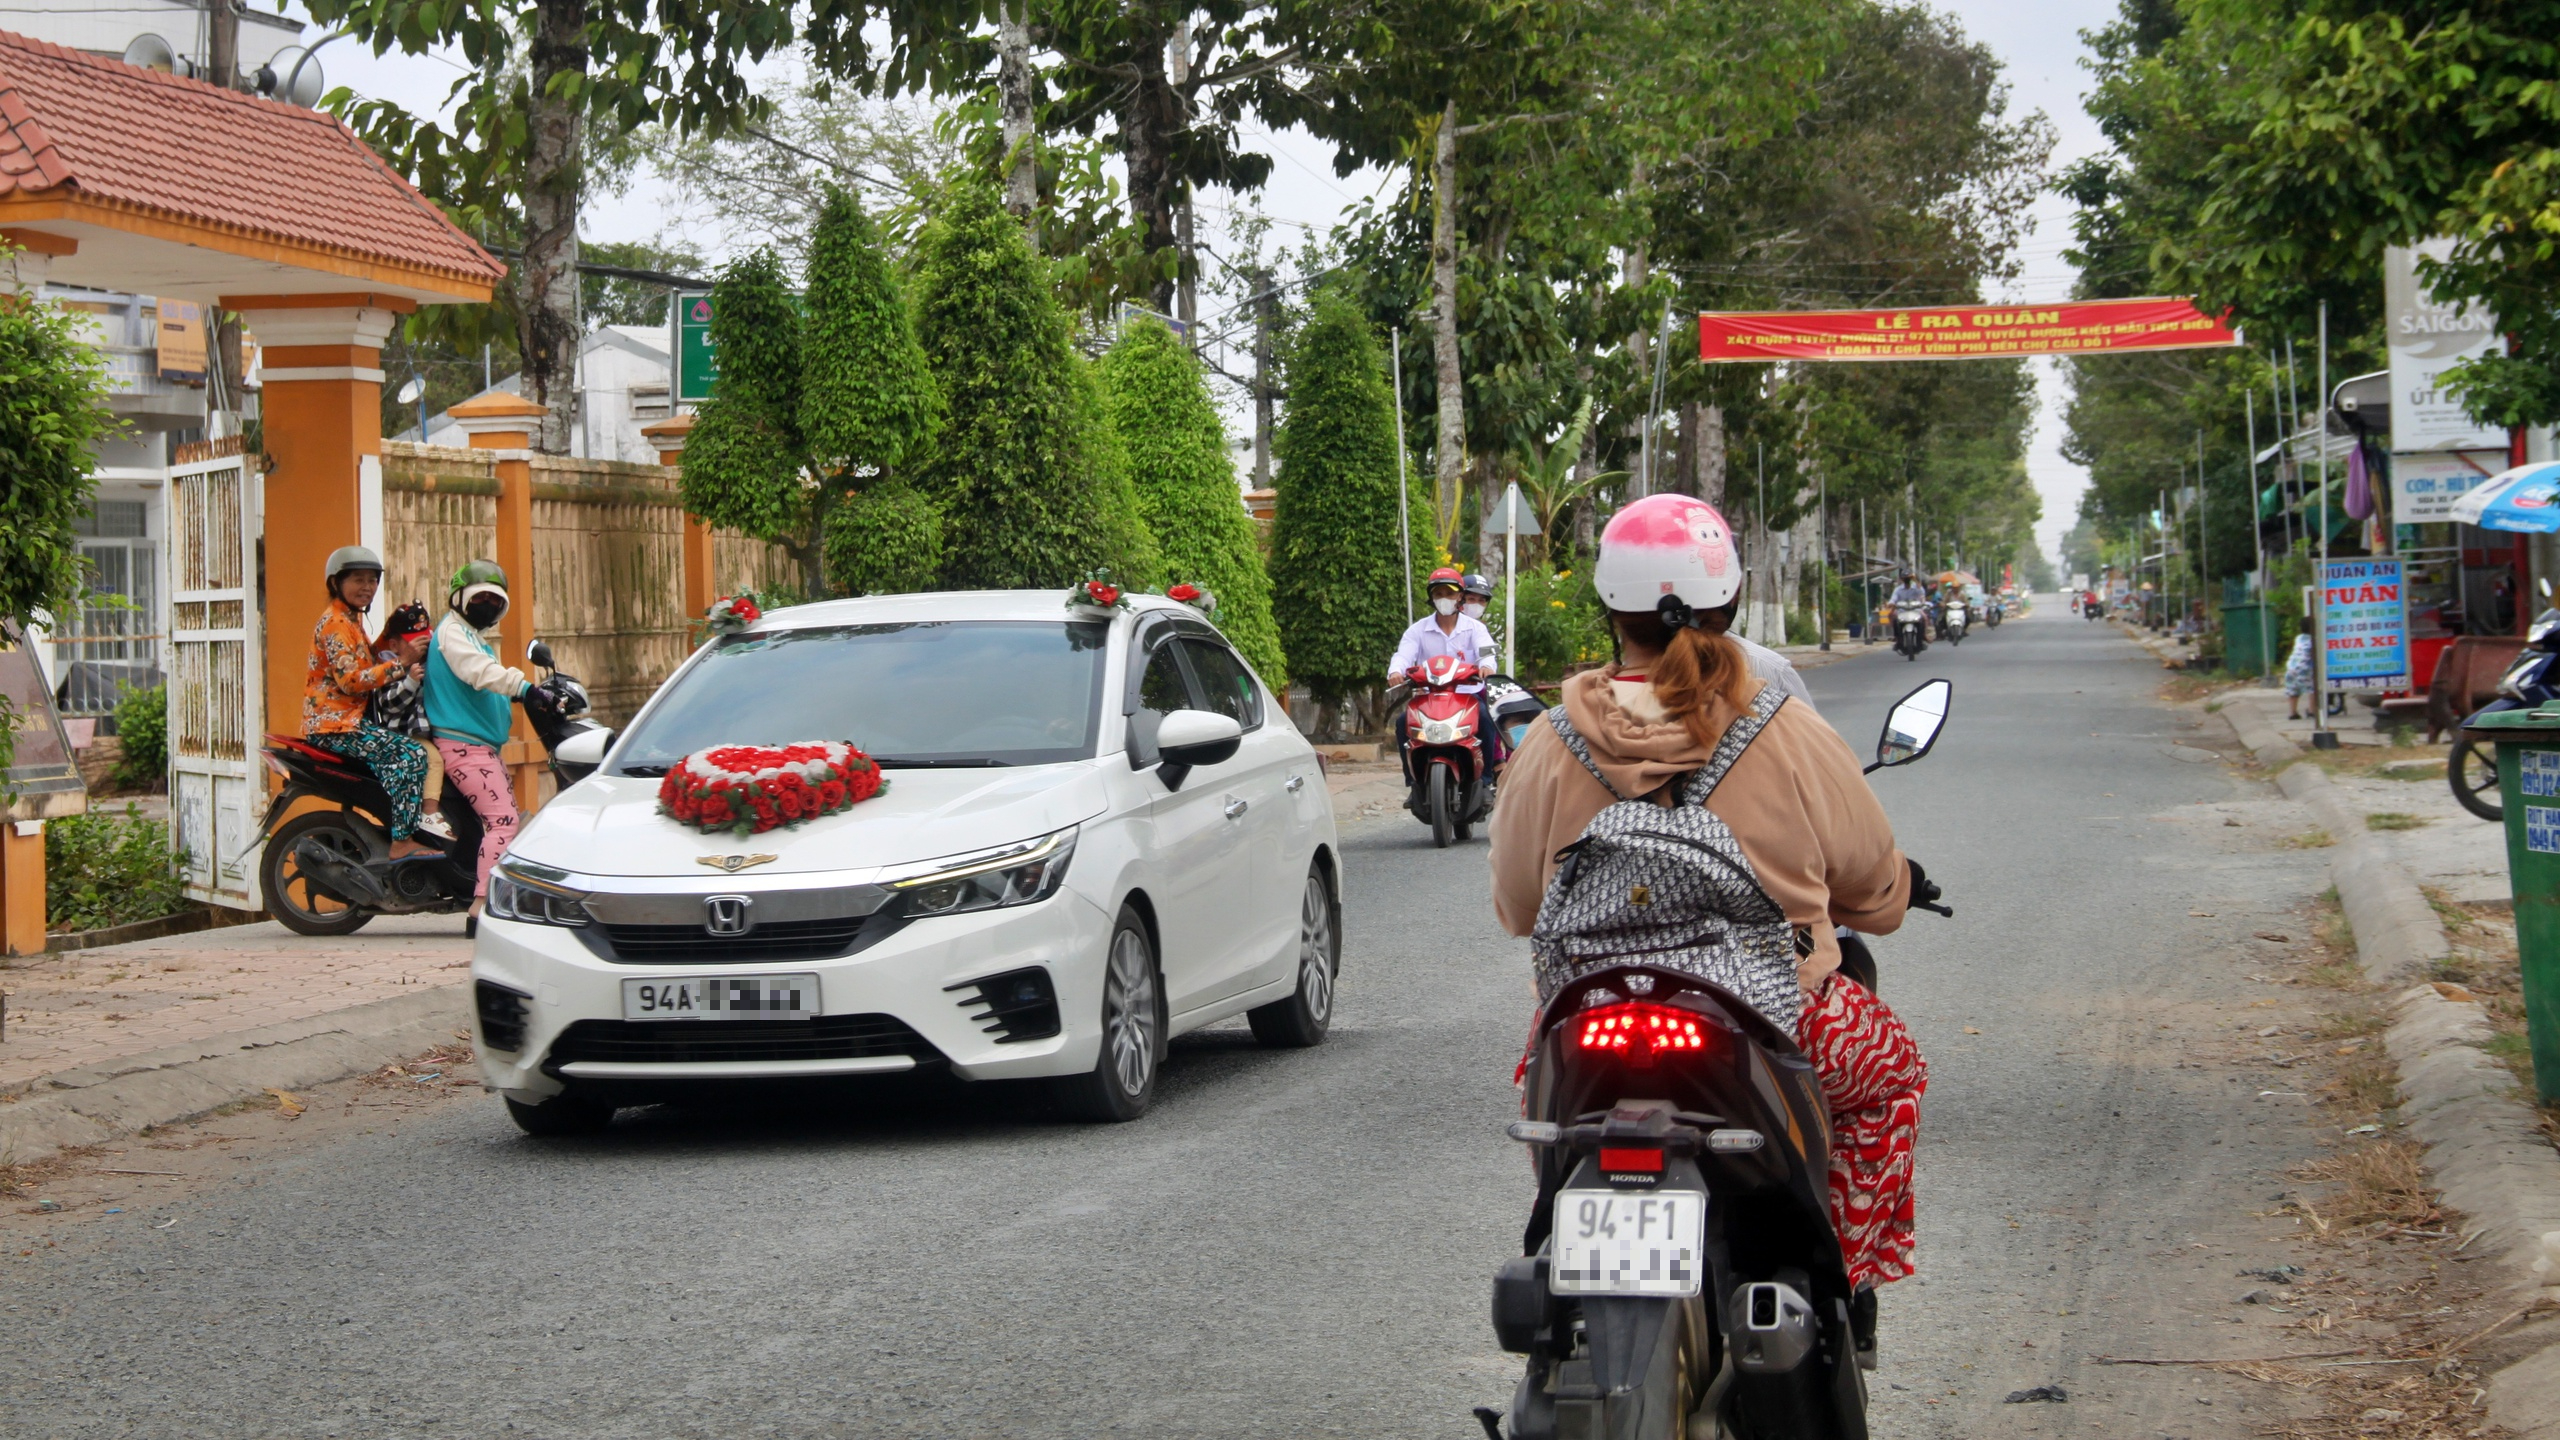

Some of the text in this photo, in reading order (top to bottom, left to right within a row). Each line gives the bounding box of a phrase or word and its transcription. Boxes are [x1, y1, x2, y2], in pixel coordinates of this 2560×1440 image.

[1876, 310, 2060, 330] LỄ RA QUÂN
[2410, 387, 2435, 405] ÚT
[2318, 580, 2398, 606] TUẤN
[2371, 635, 2398, 647] XE
[1609, 1174, 1656, 1183] HONDA
[1578, 1199, 1676, 1240] 94-F1
